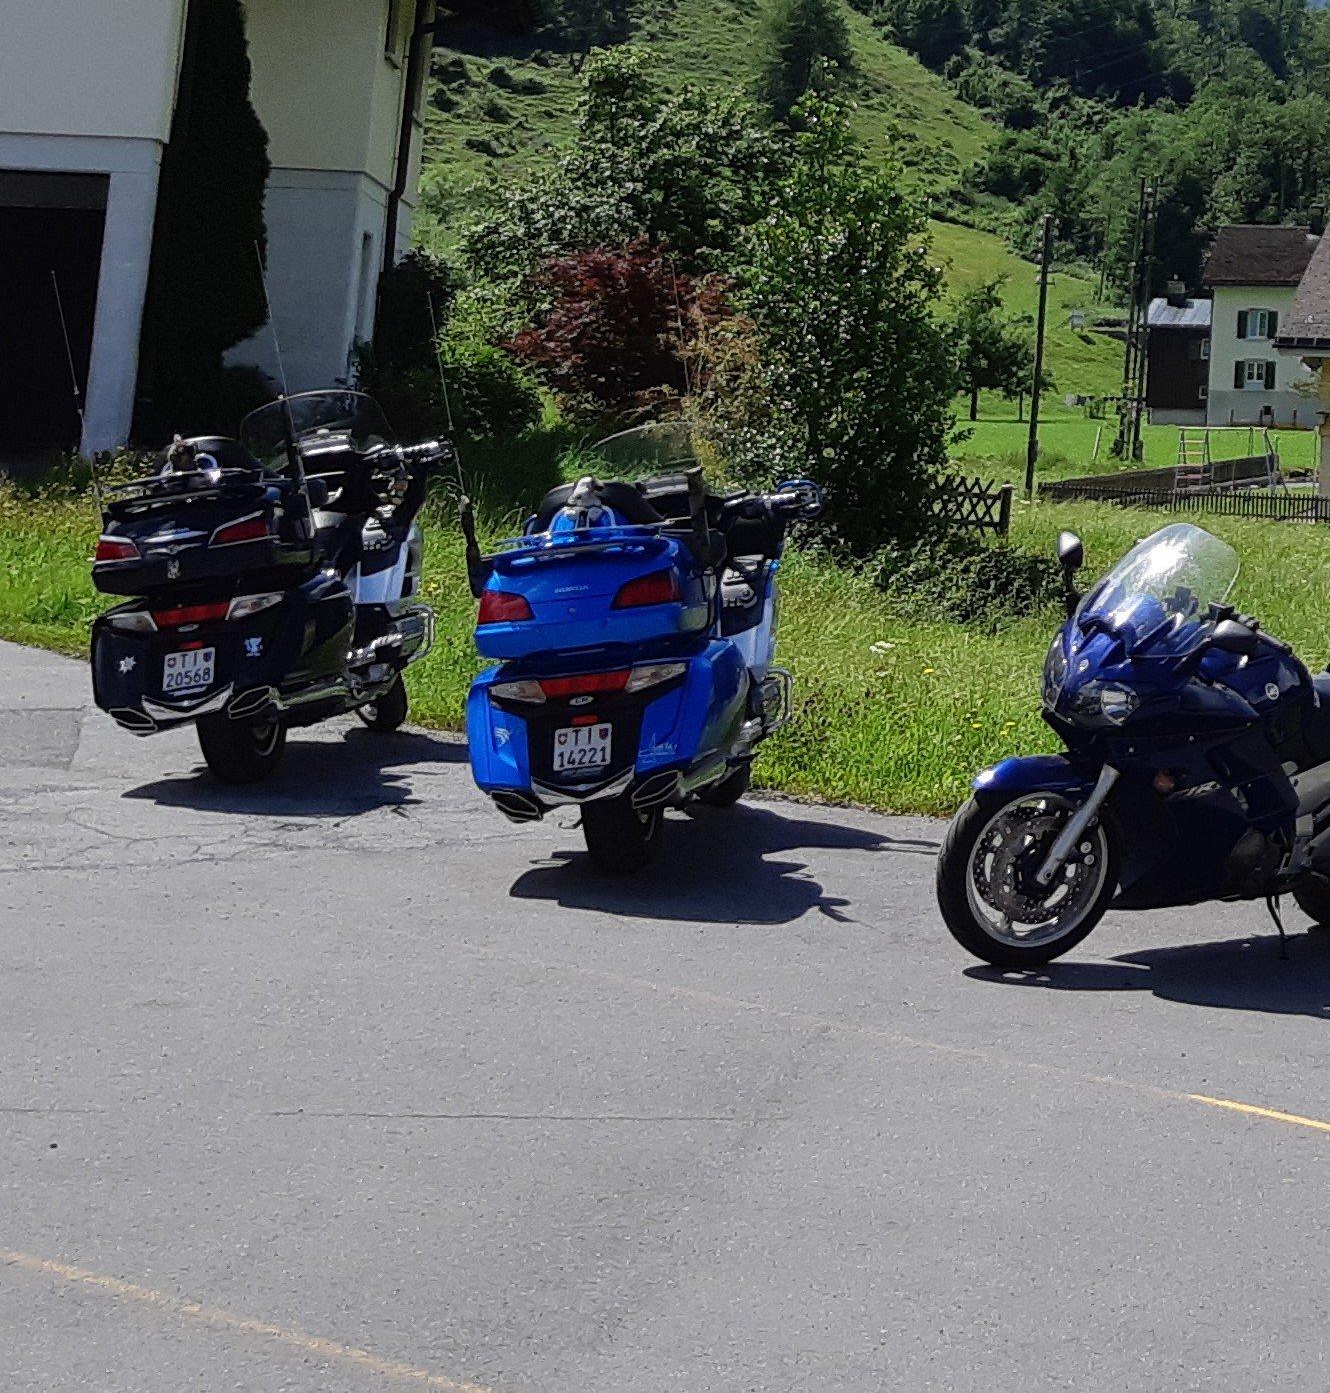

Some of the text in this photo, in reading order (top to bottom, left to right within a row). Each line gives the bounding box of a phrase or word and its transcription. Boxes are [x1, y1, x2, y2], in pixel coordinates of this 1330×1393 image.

[180, 651, 198, 669] TI
[165, 667, 211, 688] 20568
[572, 727, 592, 746] TI
[557, 746, 607, 768] 14221
